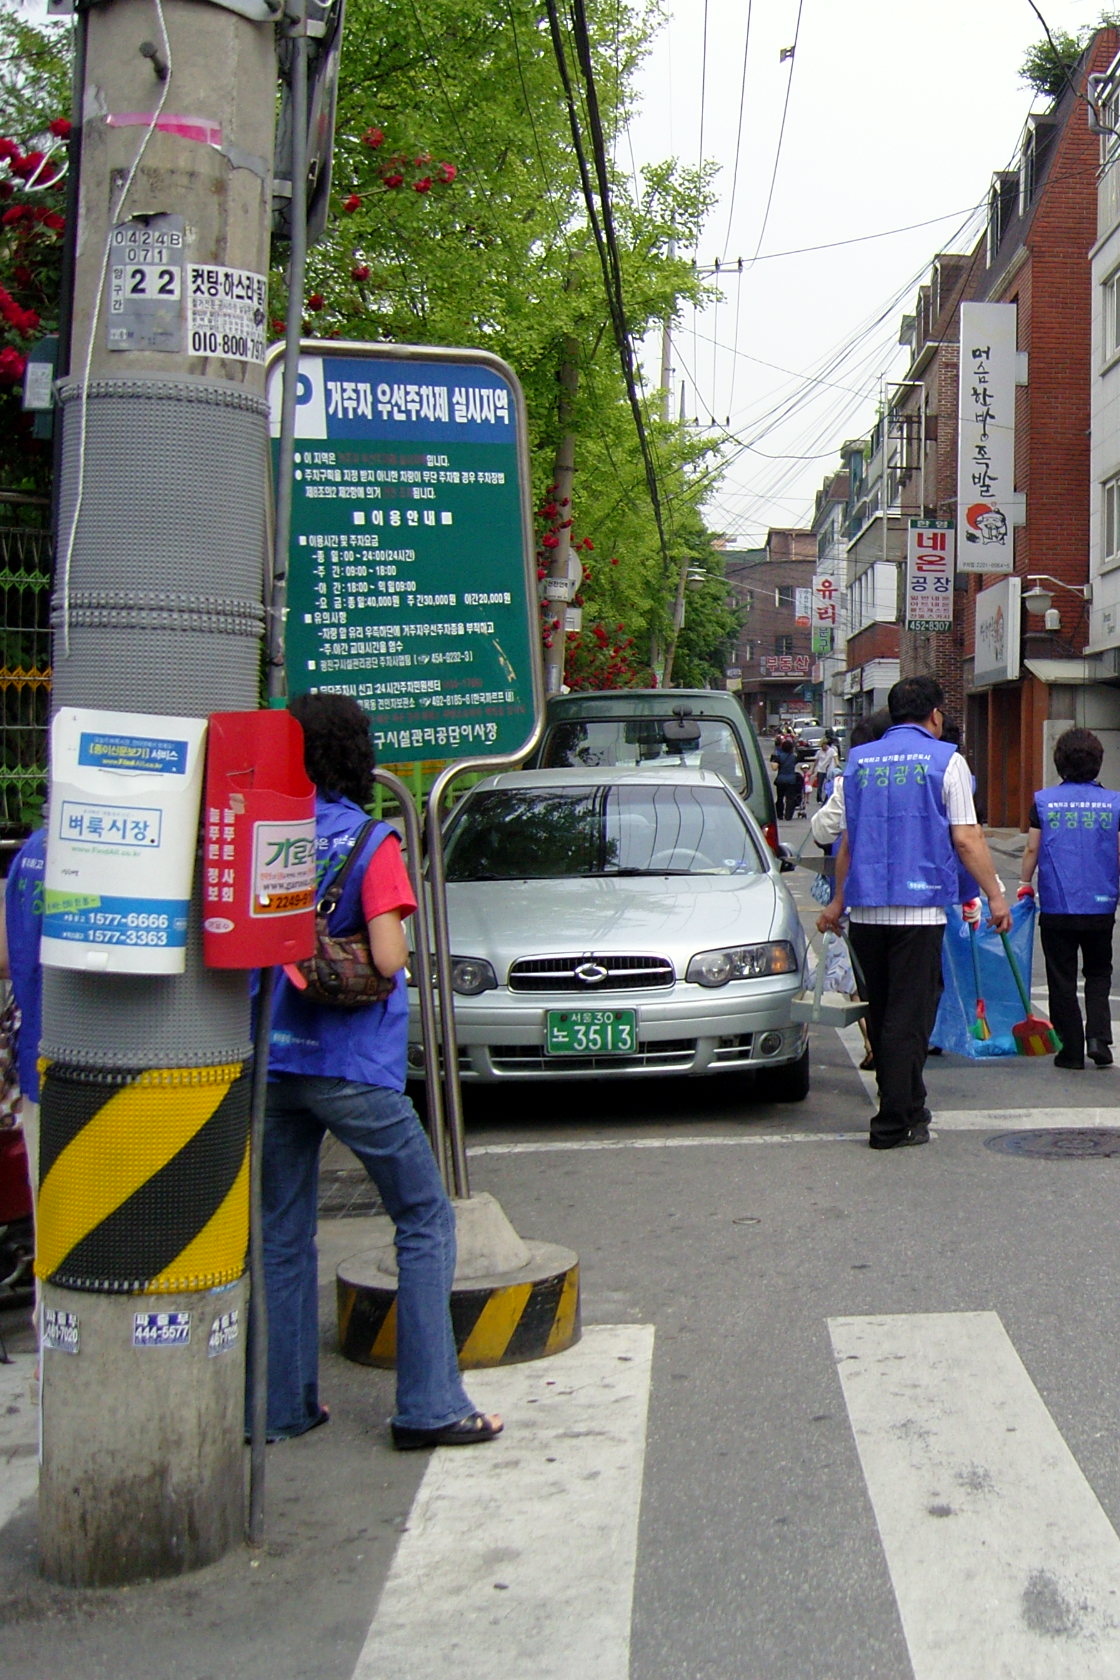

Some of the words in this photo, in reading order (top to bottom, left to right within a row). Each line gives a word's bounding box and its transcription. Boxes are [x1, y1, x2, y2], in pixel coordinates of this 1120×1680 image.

[115, 231, 181, 246] 0424B
[128, 249, 163, 262] 071
[130, 268, 176, 295] 22
[327, 381, 373, 419] 거주자
[377, 383, 449, 422] 우선주차제
[452, 387, 509, 424] 실시지역
[308, 535, 339, 548] 이용시간
[915, 532, 947, 573] 네온
[911, 575, 951, 593] 공장
[816, 578, 839, 624] 유리
[314, 612, 347, 624] 유의사항
[909, 621, 949, 631] 452-8307
[766, 655, 810, 672] 부동산
[374, 722, 498, 750] 구시설관리공단이사장
[857, 763, 929, 788] 청정광진
[68, 814, 150, 841] 벼룩시장
[1047, 811, 1113, 829] 청정광진
[208, 867, 219, 901] 정보
[222, 868, 235, 902] 사회
[89, 912, 169, 929] 1577-6666
[88, 929, 168, 946] 1577-3363
[551, 1028, 569, 1043] 노
[572, 1025, 632, 1049] 3513
